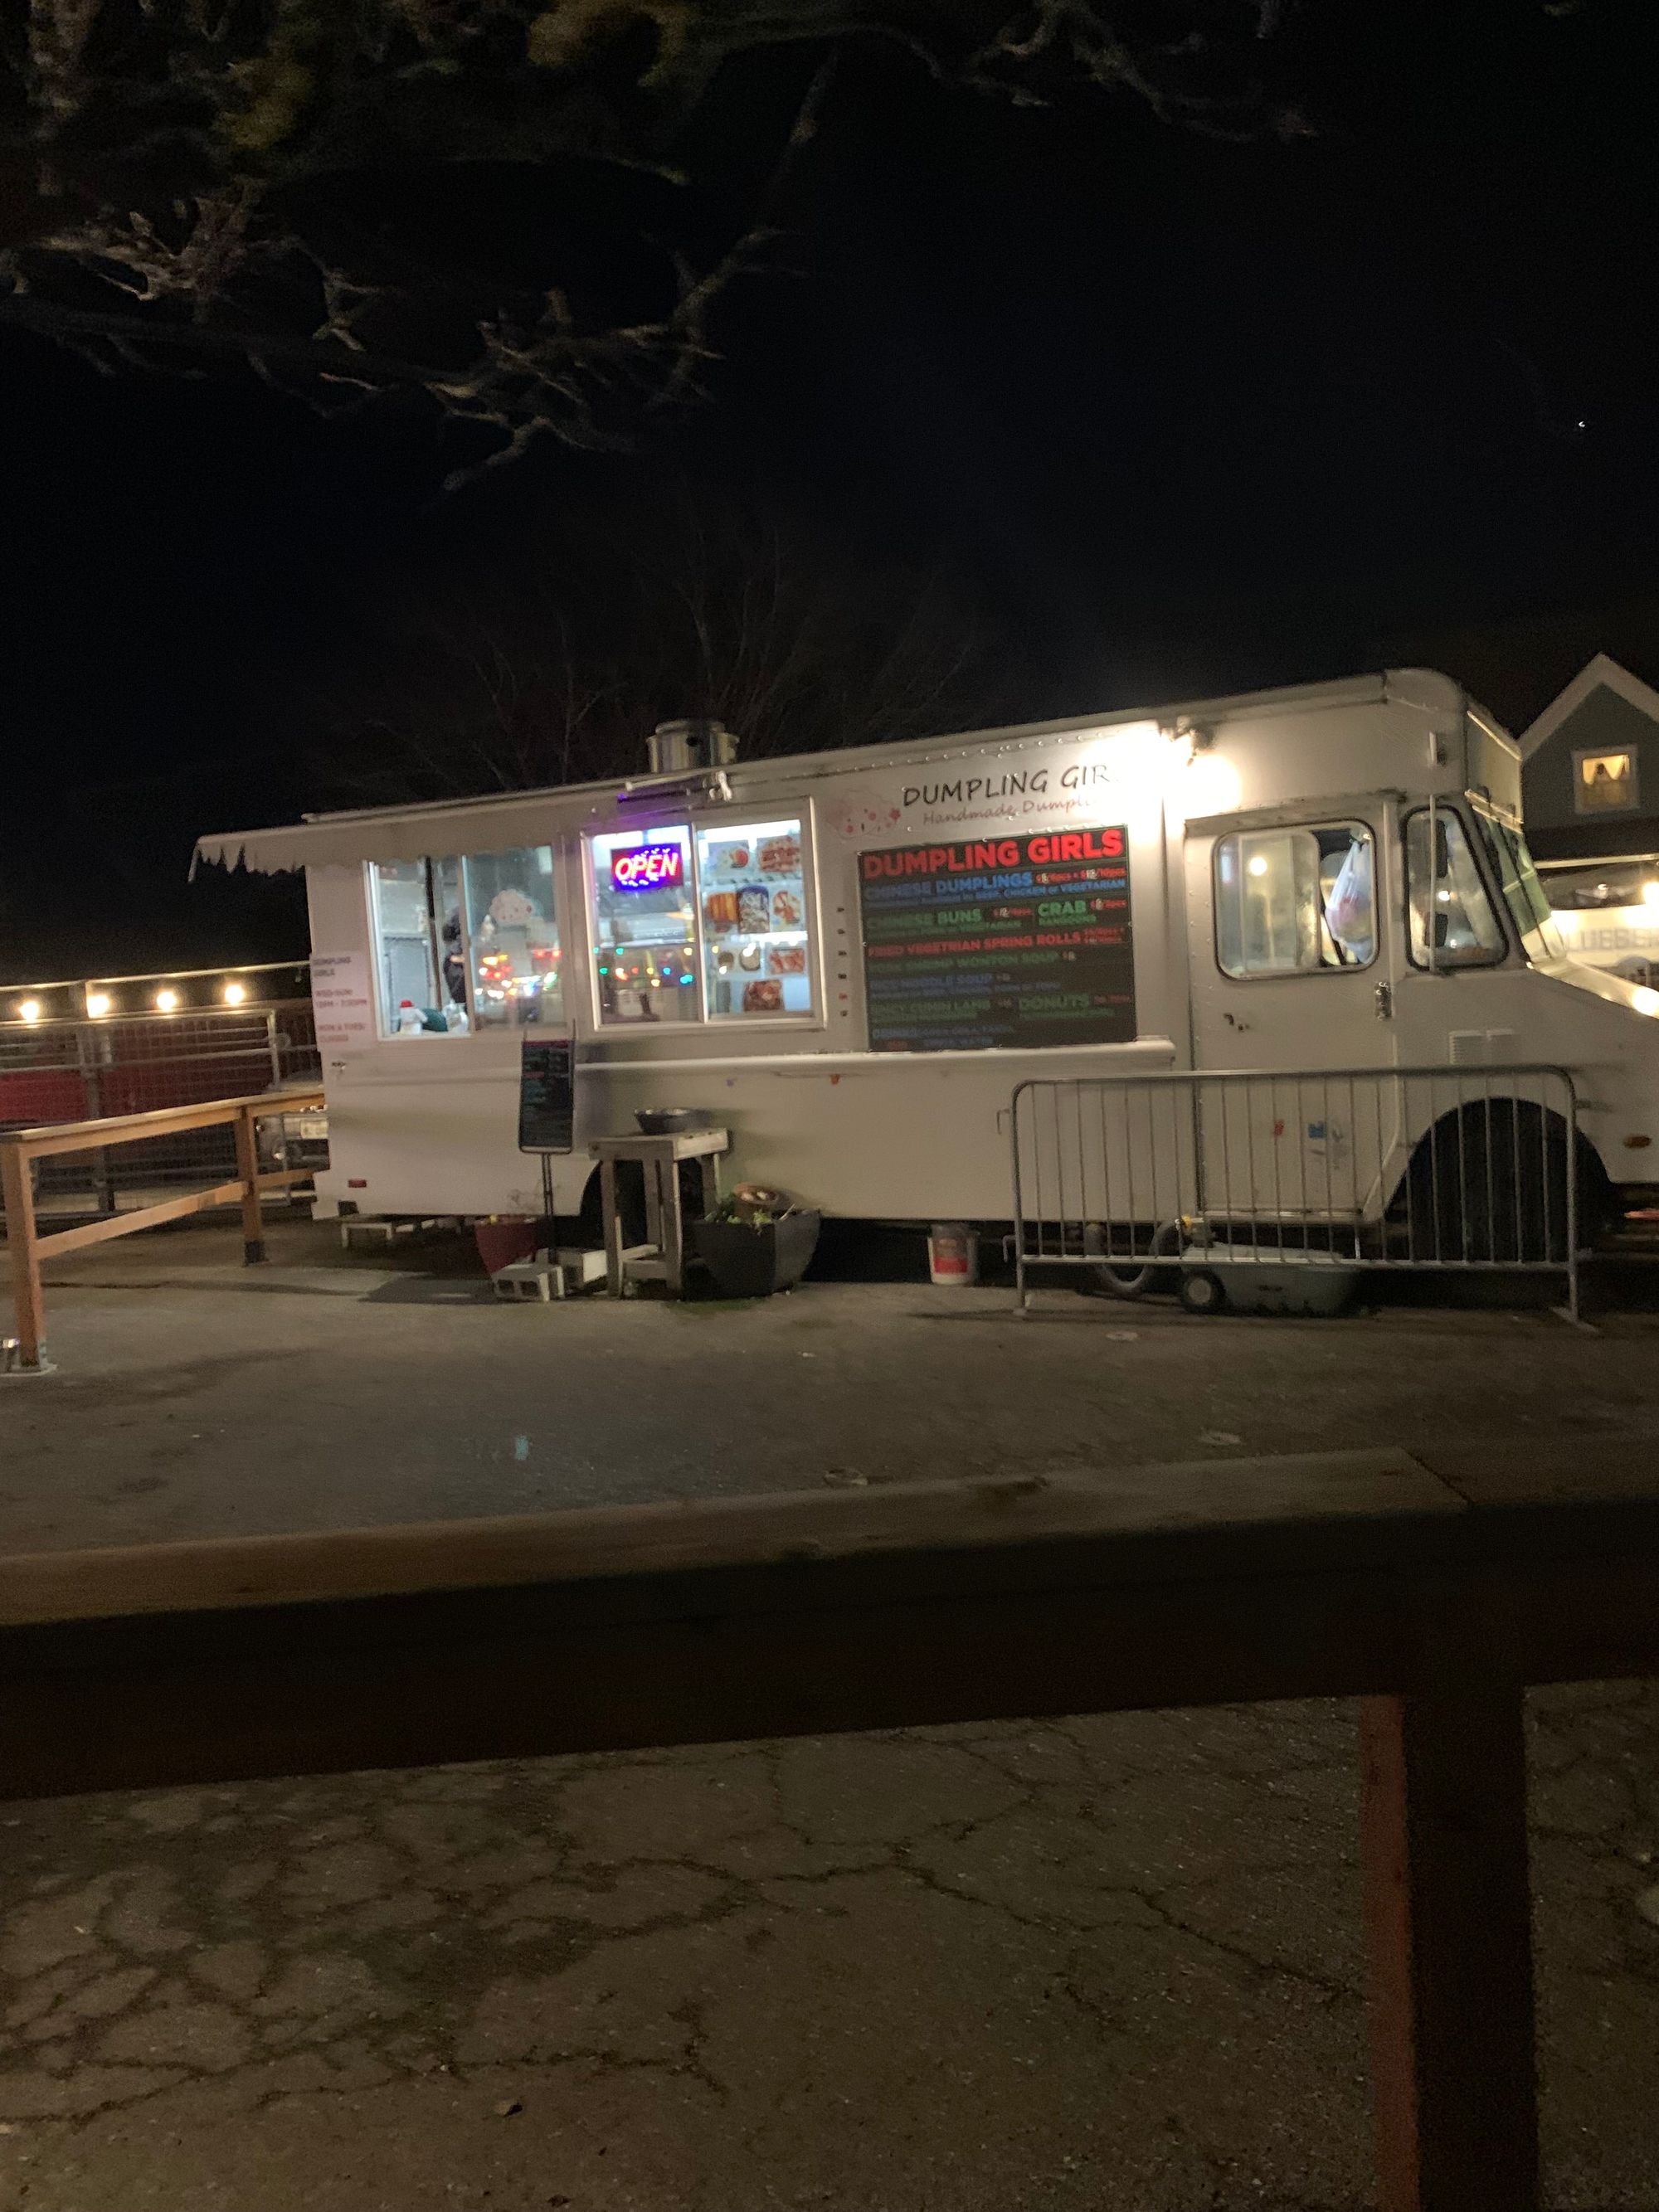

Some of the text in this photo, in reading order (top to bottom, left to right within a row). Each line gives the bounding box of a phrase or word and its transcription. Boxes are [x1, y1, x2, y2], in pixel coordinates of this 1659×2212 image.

[903, 764, 1112, 807] DUMPLING GIR
[922, 795, 1092, 825] Handmade Dumpli
[864, 828, 1124, 880] DUMPLING GIRLS
[615, 853, 679, 881] OPEN
[936, 871, 1033, 893] DUMPLINGS
[937, 908, 982, 925] BUNS
[1038, 900, 1087, 917] CRAB
[983, 935, 1034, 950] SPRING
[1036, 930, 1082, 946] ROLLS
[1019, 994, 1090, 1010] DONUTS
